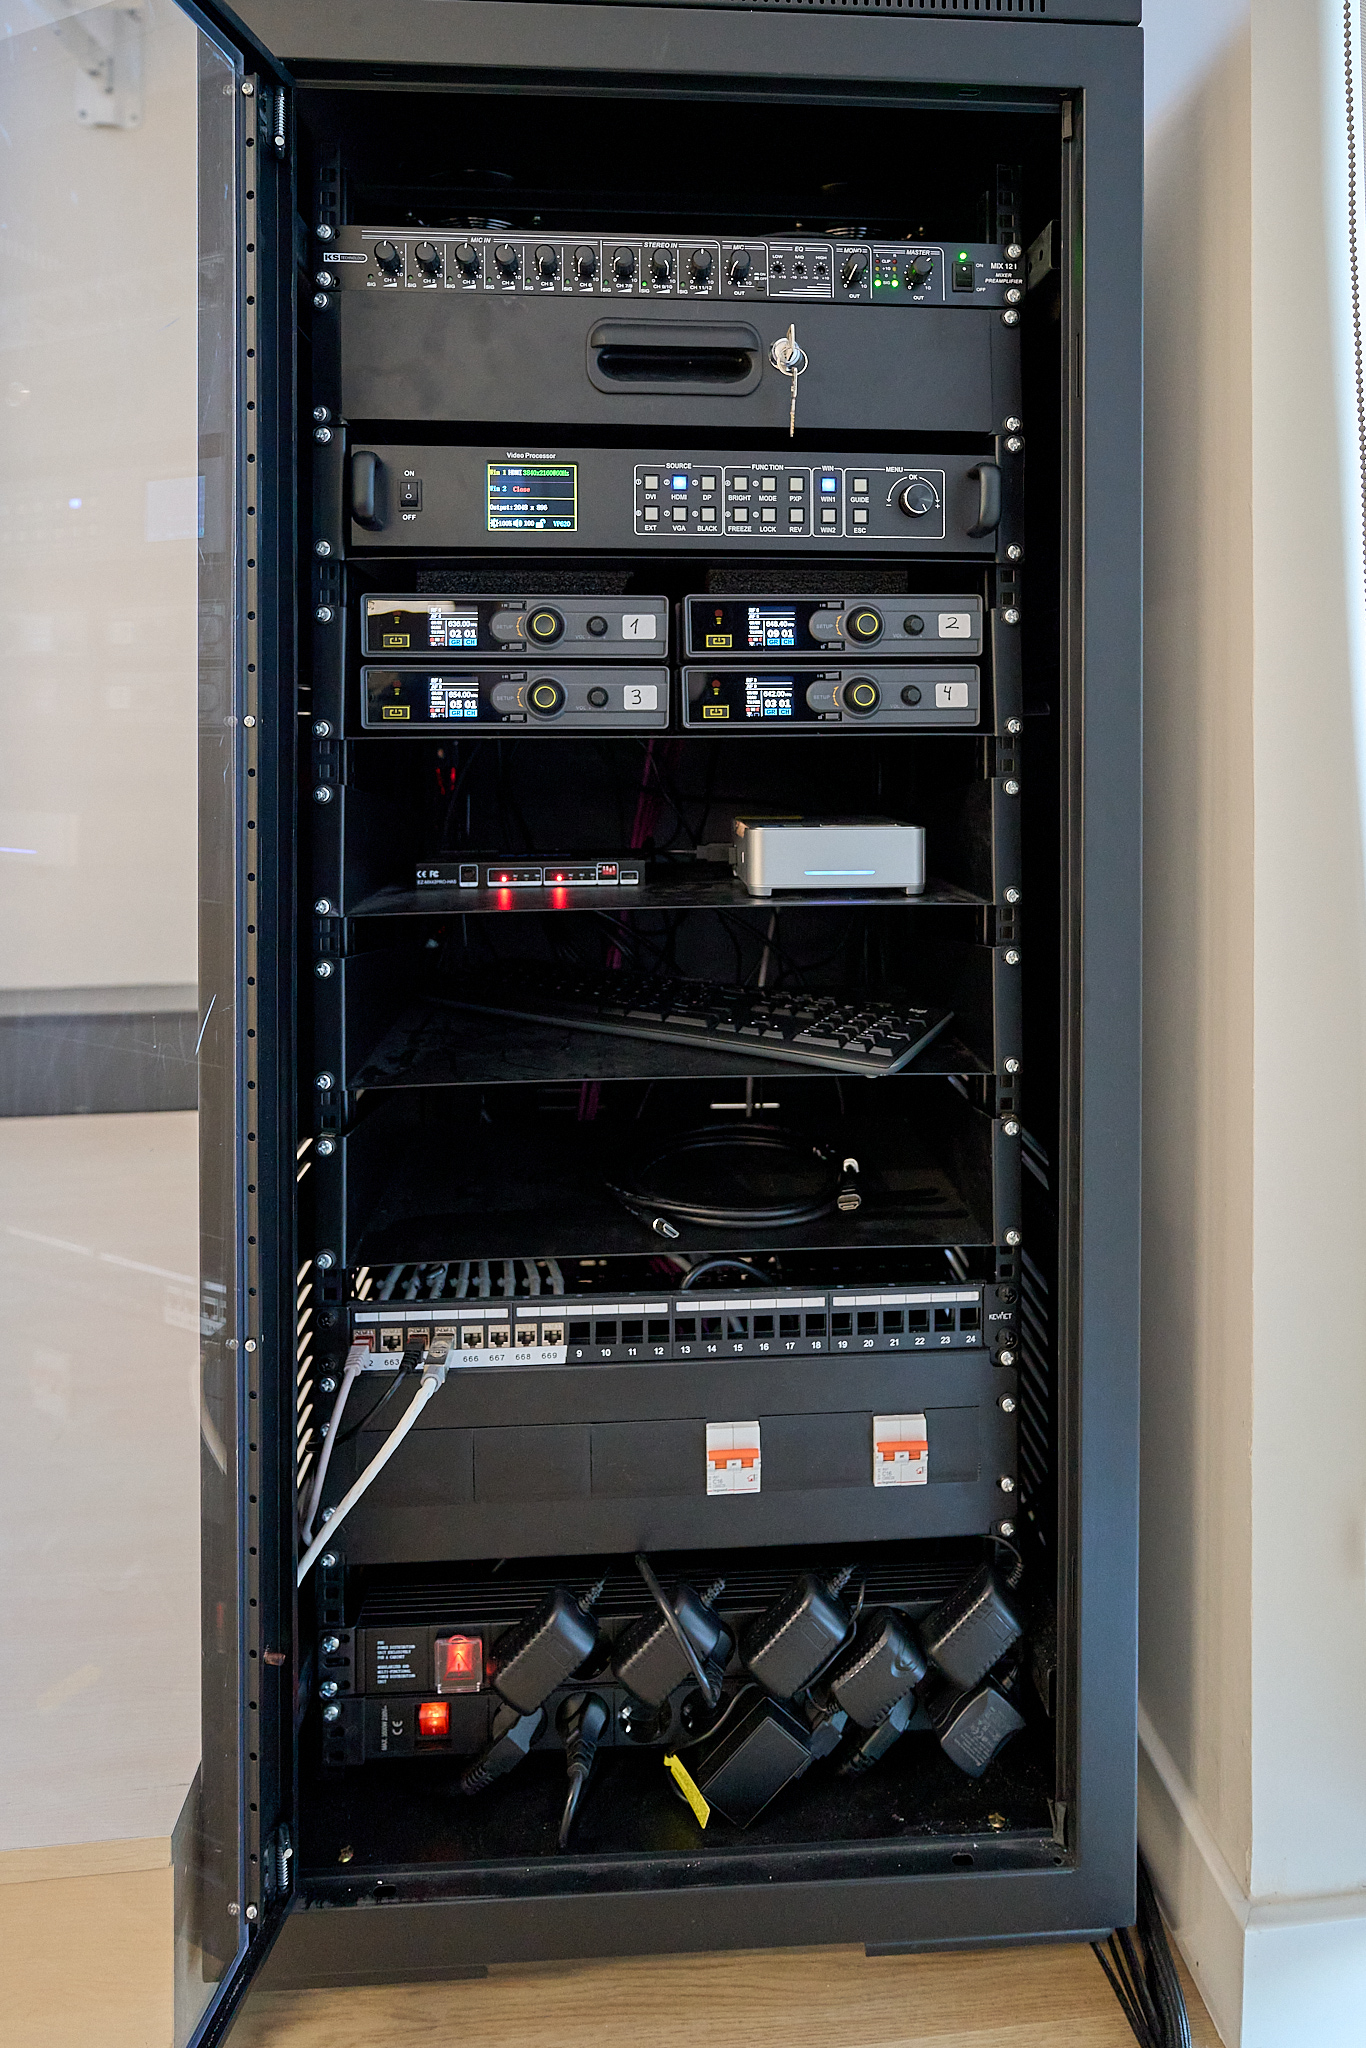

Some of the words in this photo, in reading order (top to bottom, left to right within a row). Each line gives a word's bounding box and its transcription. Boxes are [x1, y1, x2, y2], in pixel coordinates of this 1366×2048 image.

[630, 618, 639, 634] 1
[945, 617, 959, 629] 2
[449, 630, 462, 638] 02
[464, 630, 476, 638] 01
[767, 629, 780, 638] 09
[781, 629, 794, 638] 01
[631, 689, 642, 705] 3
[943, 686, 951, 701] 4
[449, 700, 462, 708] 05
[464, 700, 477, 709] 01
[779, 699, 791, 707] 01
[576, 1350, 583, 1358] 9
[601, 1348, 611, 1357] 10
[627, 1348, 637, 1356] 11
[653, 1347, 664, 1355] 12
[680, 1346, 691, 1354] 13
[706, 1345, 717, 1353] 14
[732, 1344, 743, 1352] 15
[759, 1343, 770, 1351] 16
[785, 1342, 796, 1350] 17
[811, 1341, 822, 1349] 18
[837, 1340, 848, 1349] 19
[863, 1340, 874, 1348] 20
[889, 1338, 900, 1346] 21
[914, 1337, 926, 1346] 22
[940, 1336, 951, 1344] 23
[966, 1335, 976, 1343] 24
[392, 1720, 403, 1735] CE
